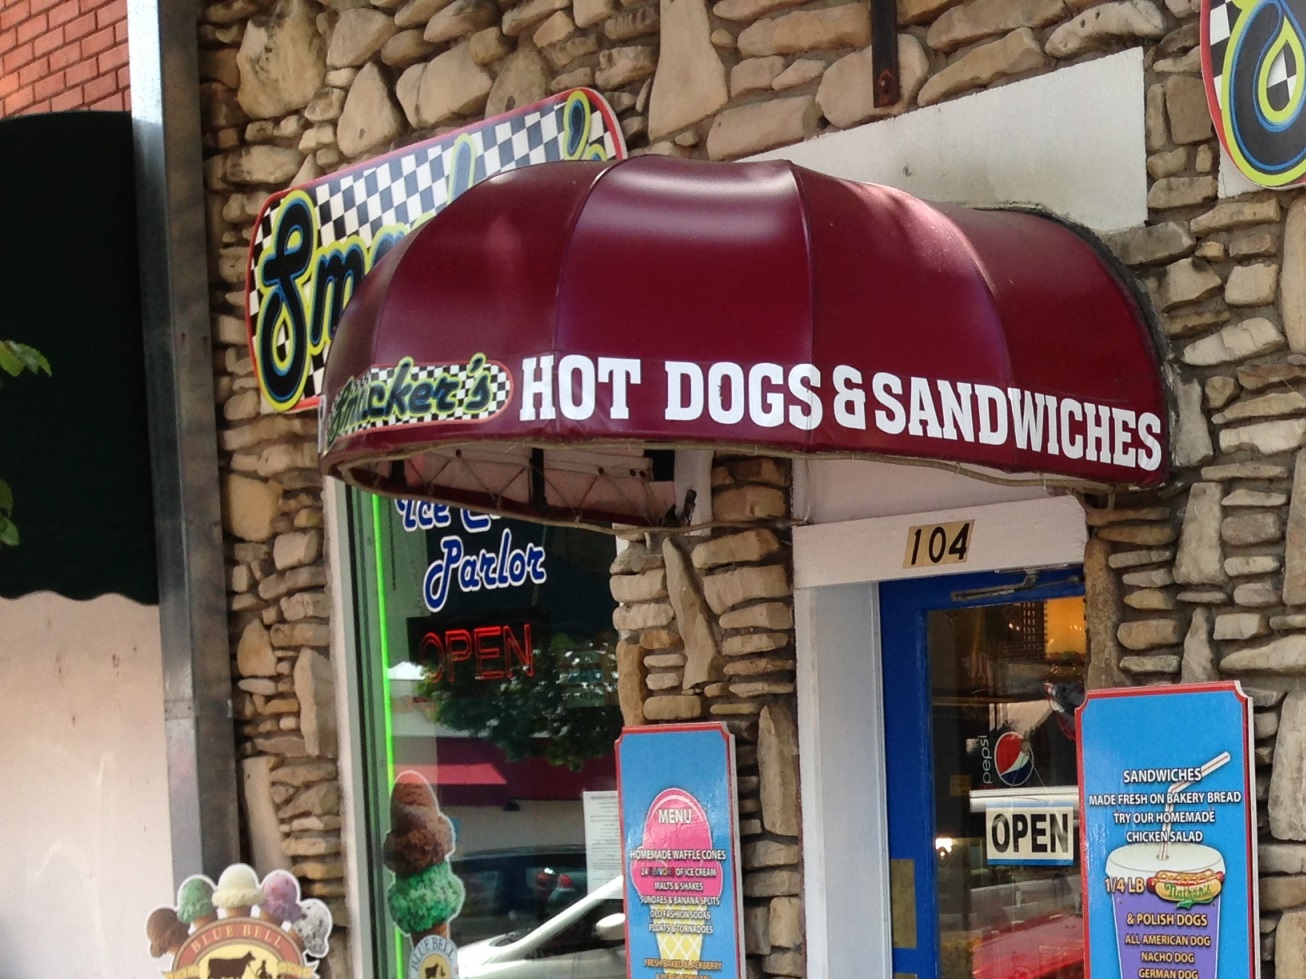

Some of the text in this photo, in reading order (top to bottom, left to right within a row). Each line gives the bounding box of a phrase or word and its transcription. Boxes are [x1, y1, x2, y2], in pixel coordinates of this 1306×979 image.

[519, 354, 1162, 471] HOT DOGS & SANDWICHES
[911, 523, 970, 565] 104
[424, 528, 547, 612] Parlor
[420, 623, 535, 684] OPEN
[977, 735, 992, 784] pepsi
[1124, 768, 1202, 783] SANDWICHES
[1089, 791, 1241, 805] MADE FRESH ON BAKERY BREAD
[659, 809, 692, 823] MENU
[1113, 812, 1215, 823] TRY OUR HOMEMADE
[991, 813, 1069, 853] OPEN
[1126, 831, 1203, 842] CHICKEN SALAD
[630, 850, 726, 859] HOMEMADE WAFFLE CONES
[676, 868, 684, 876] OF
[685, 868, 694, 876] ICE
[695, 868, 716, 876] CREAM
[655, 882, 674, 890] MALTS
[681, 882, 703, 890] SHAKES
[1105, 877, 1144, 893] 1/4 LB
[1127, 913, 1208, 926] & POLISH DOGS
[191, 925, 283, 952] BLUE BELL
[1125, 935, 1210, 946] ALL AMERICAN DOG
[1142, 952, 1194, 963] NACHO DOG
[1138, 969, 1198, 979] GERMAN DOG
